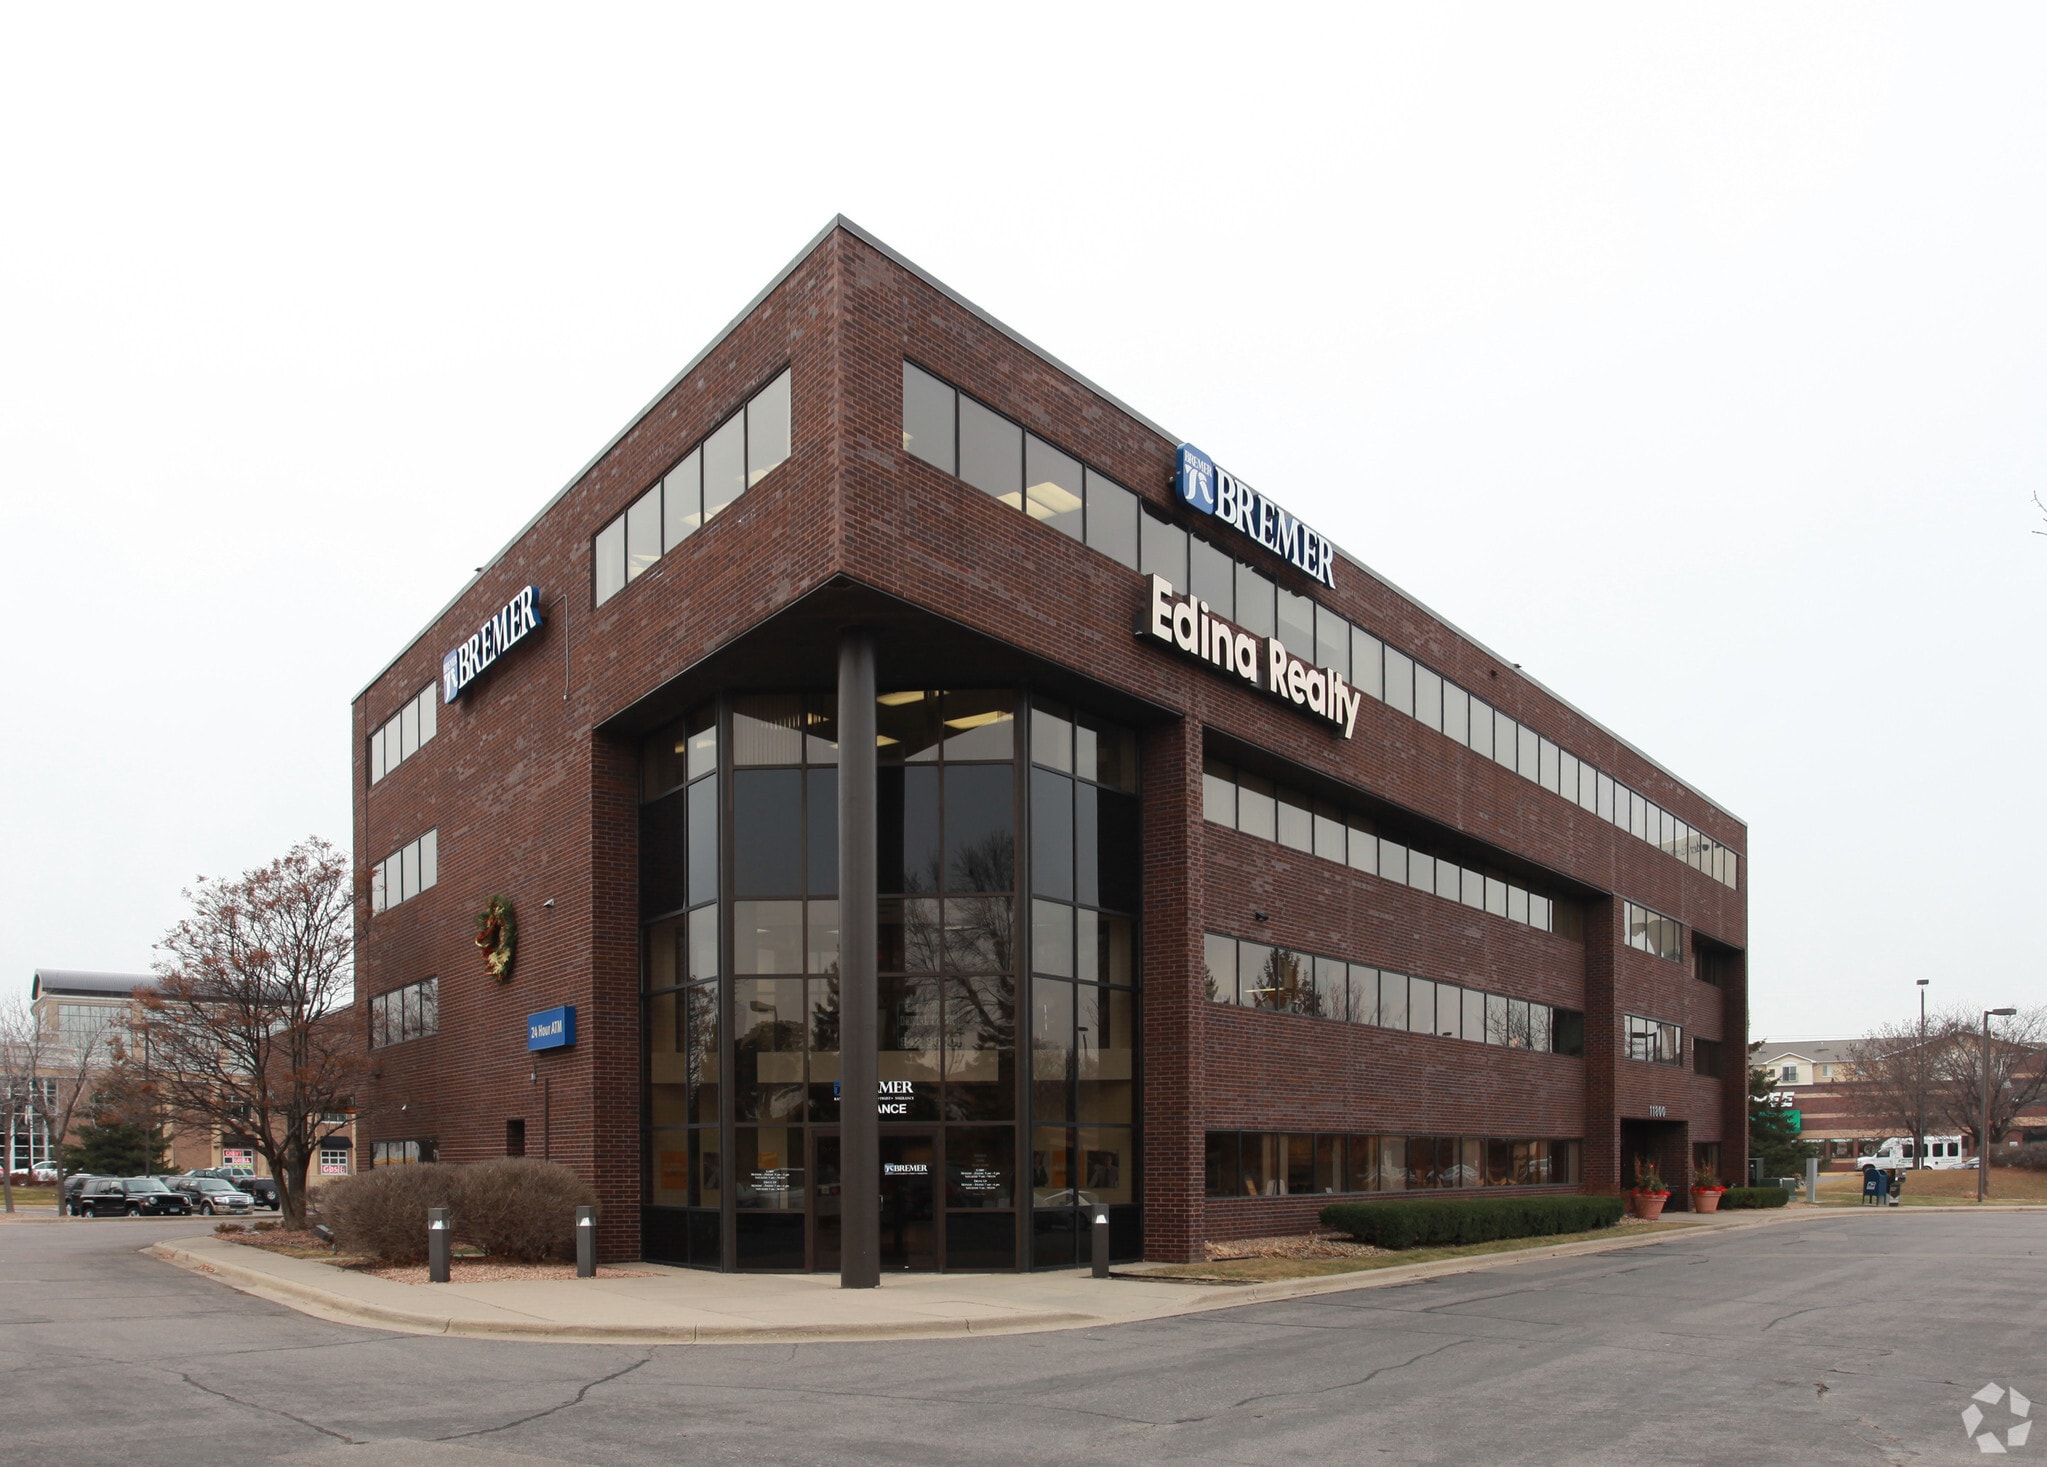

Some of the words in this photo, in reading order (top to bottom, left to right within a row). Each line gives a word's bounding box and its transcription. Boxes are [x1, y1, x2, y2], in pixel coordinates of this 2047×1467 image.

[1184, 450, 1213, 478] BREMER
[1214, 466, 1336, 589] BREMER
[457, 585, 537, 689] BREMER
[1152, 573, 1258, 684] Edina
[1268, 636, 1361, 739] Realty
[530, 1026, 538, 1039] 24
[538, 1024, 551, 1037] Hour
[550, 1019, 563, 1034] ATM
[877, 1081, 914, 1094] MER
[894, 1164, 928, 1172] BREMER
